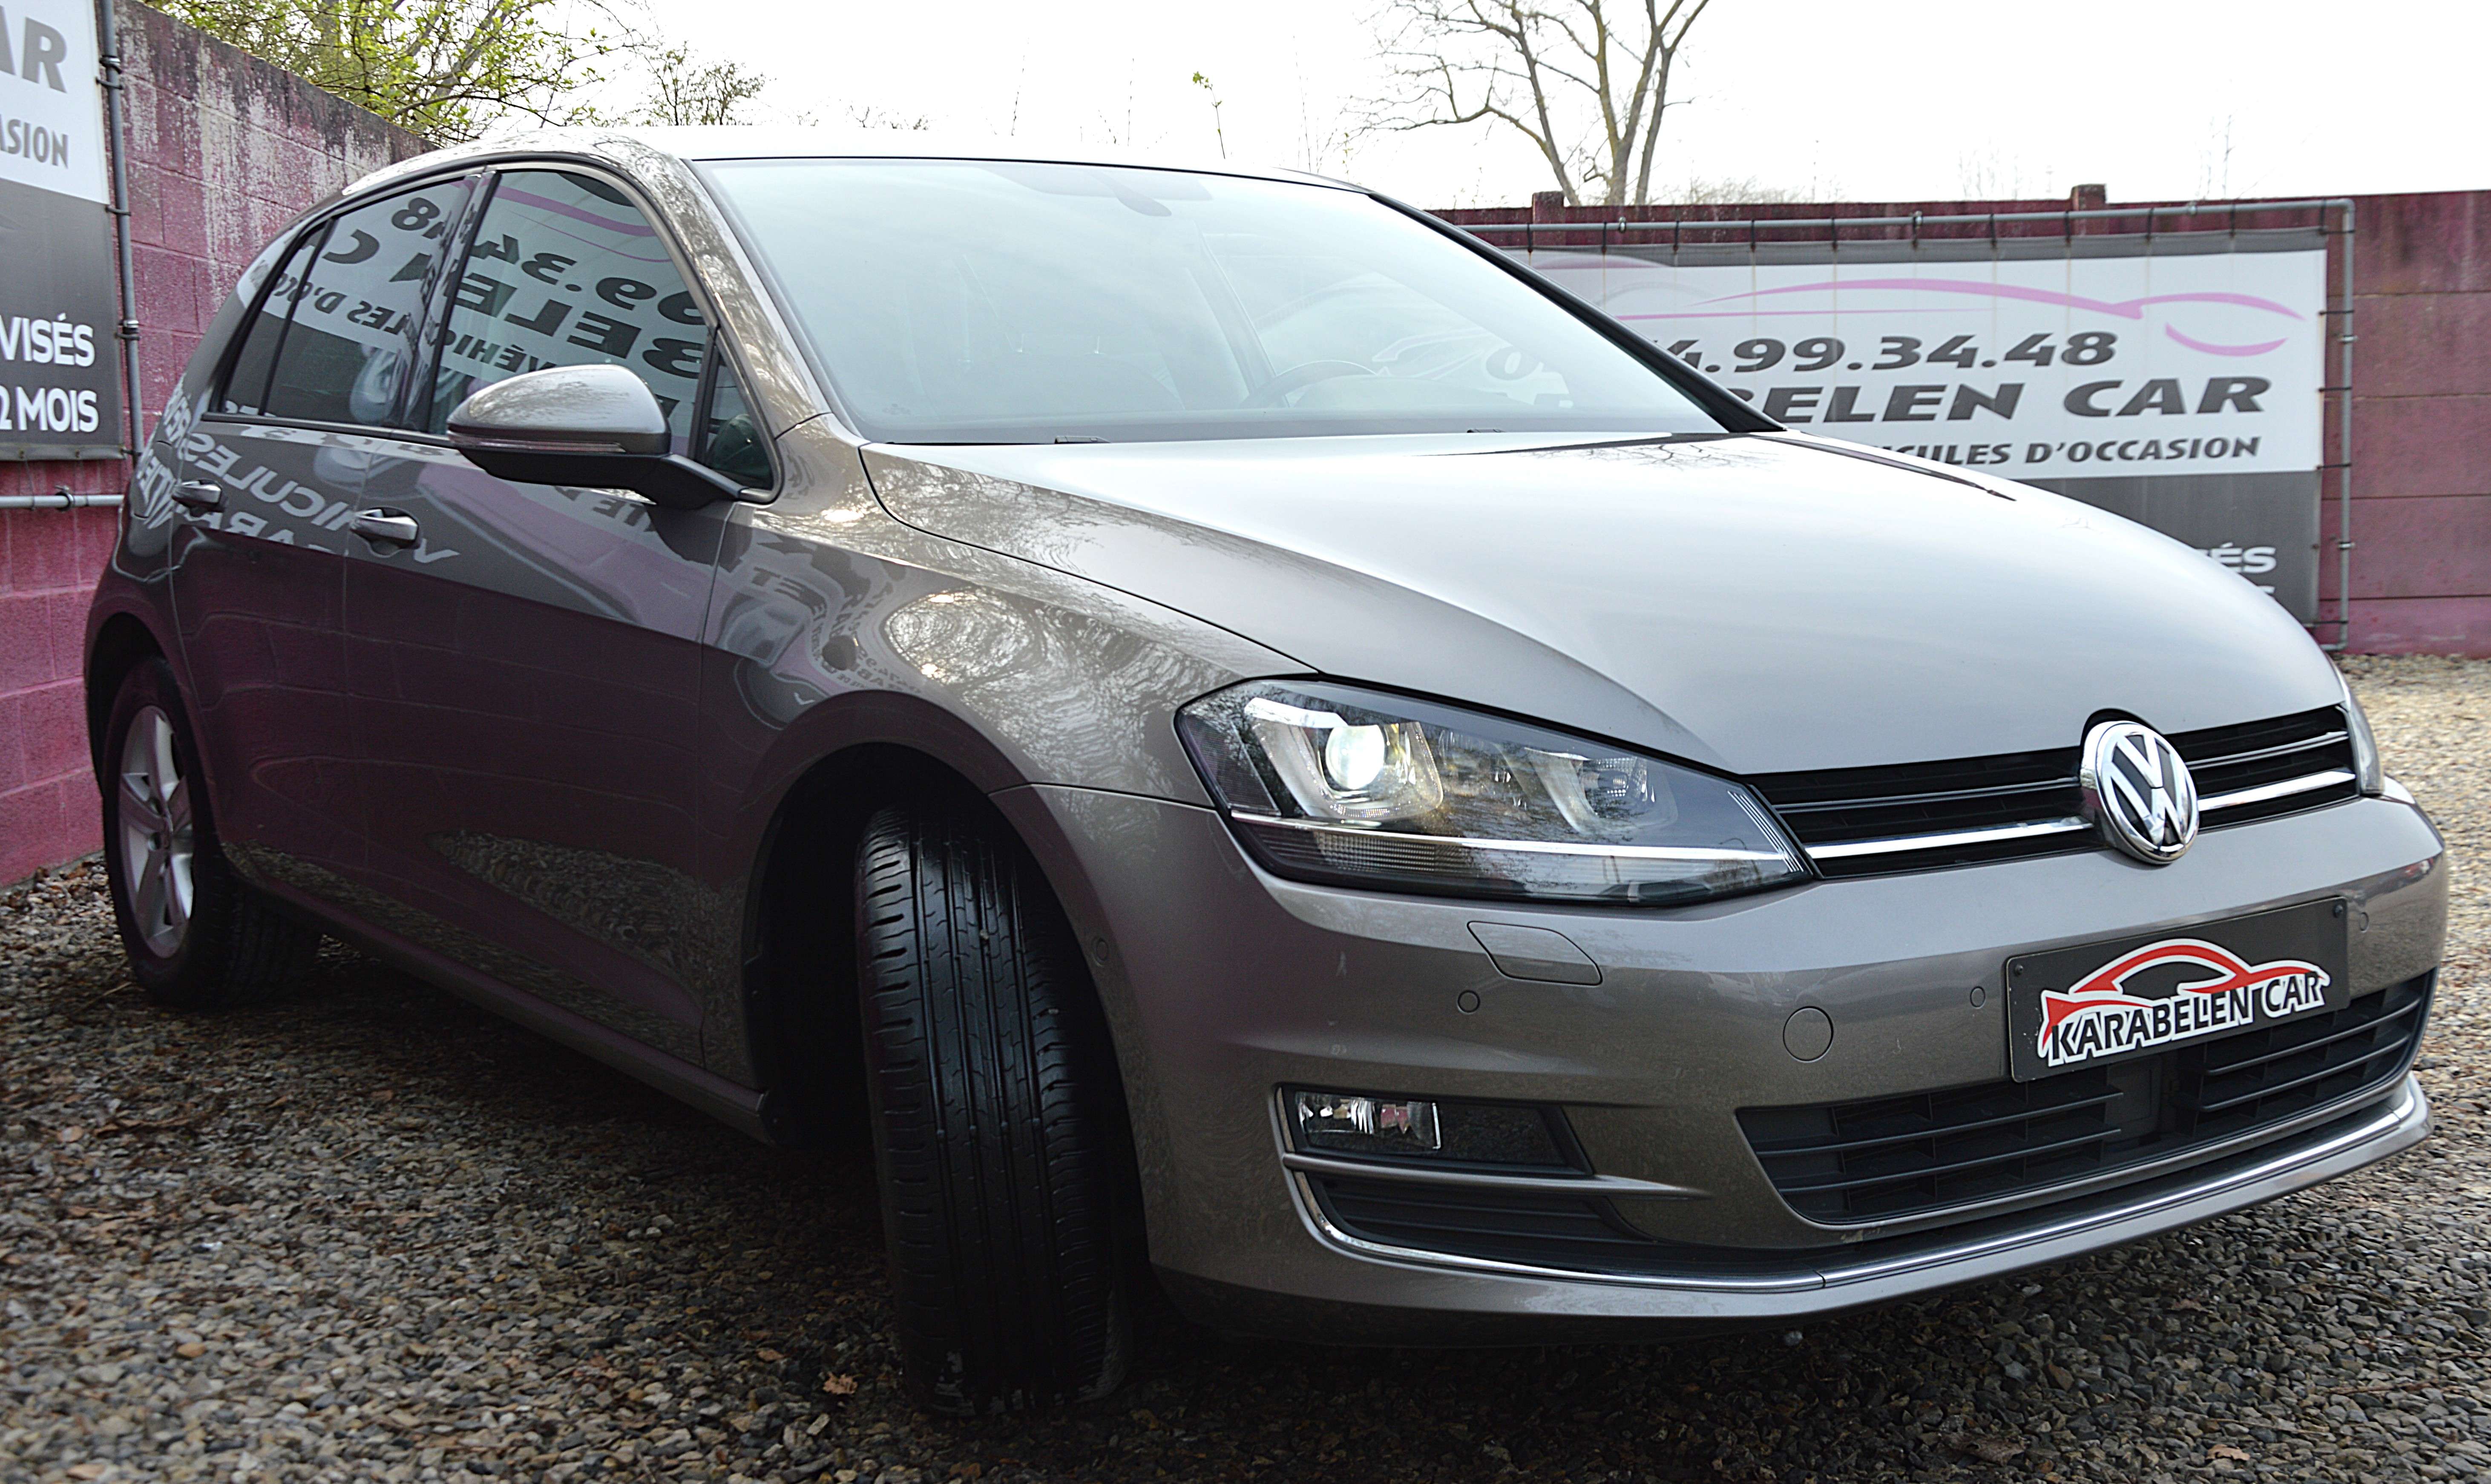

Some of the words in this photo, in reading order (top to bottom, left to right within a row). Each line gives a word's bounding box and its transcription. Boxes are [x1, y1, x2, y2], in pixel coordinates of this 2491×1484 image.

[0, 114, 69, 169] SION
[15, 386, 99, 433] MOIS
[1727, 382, 2026, 423] ELEN
[2064, 376, 2272, 417] CAR
[1883, 443, 2013, 465] ULES
[2025, 436, 2262, 464] D'OCCASION
[2049, 986, 2254, 1063] KARABELEN
[2263, 971, 2325, 1013] CAR
